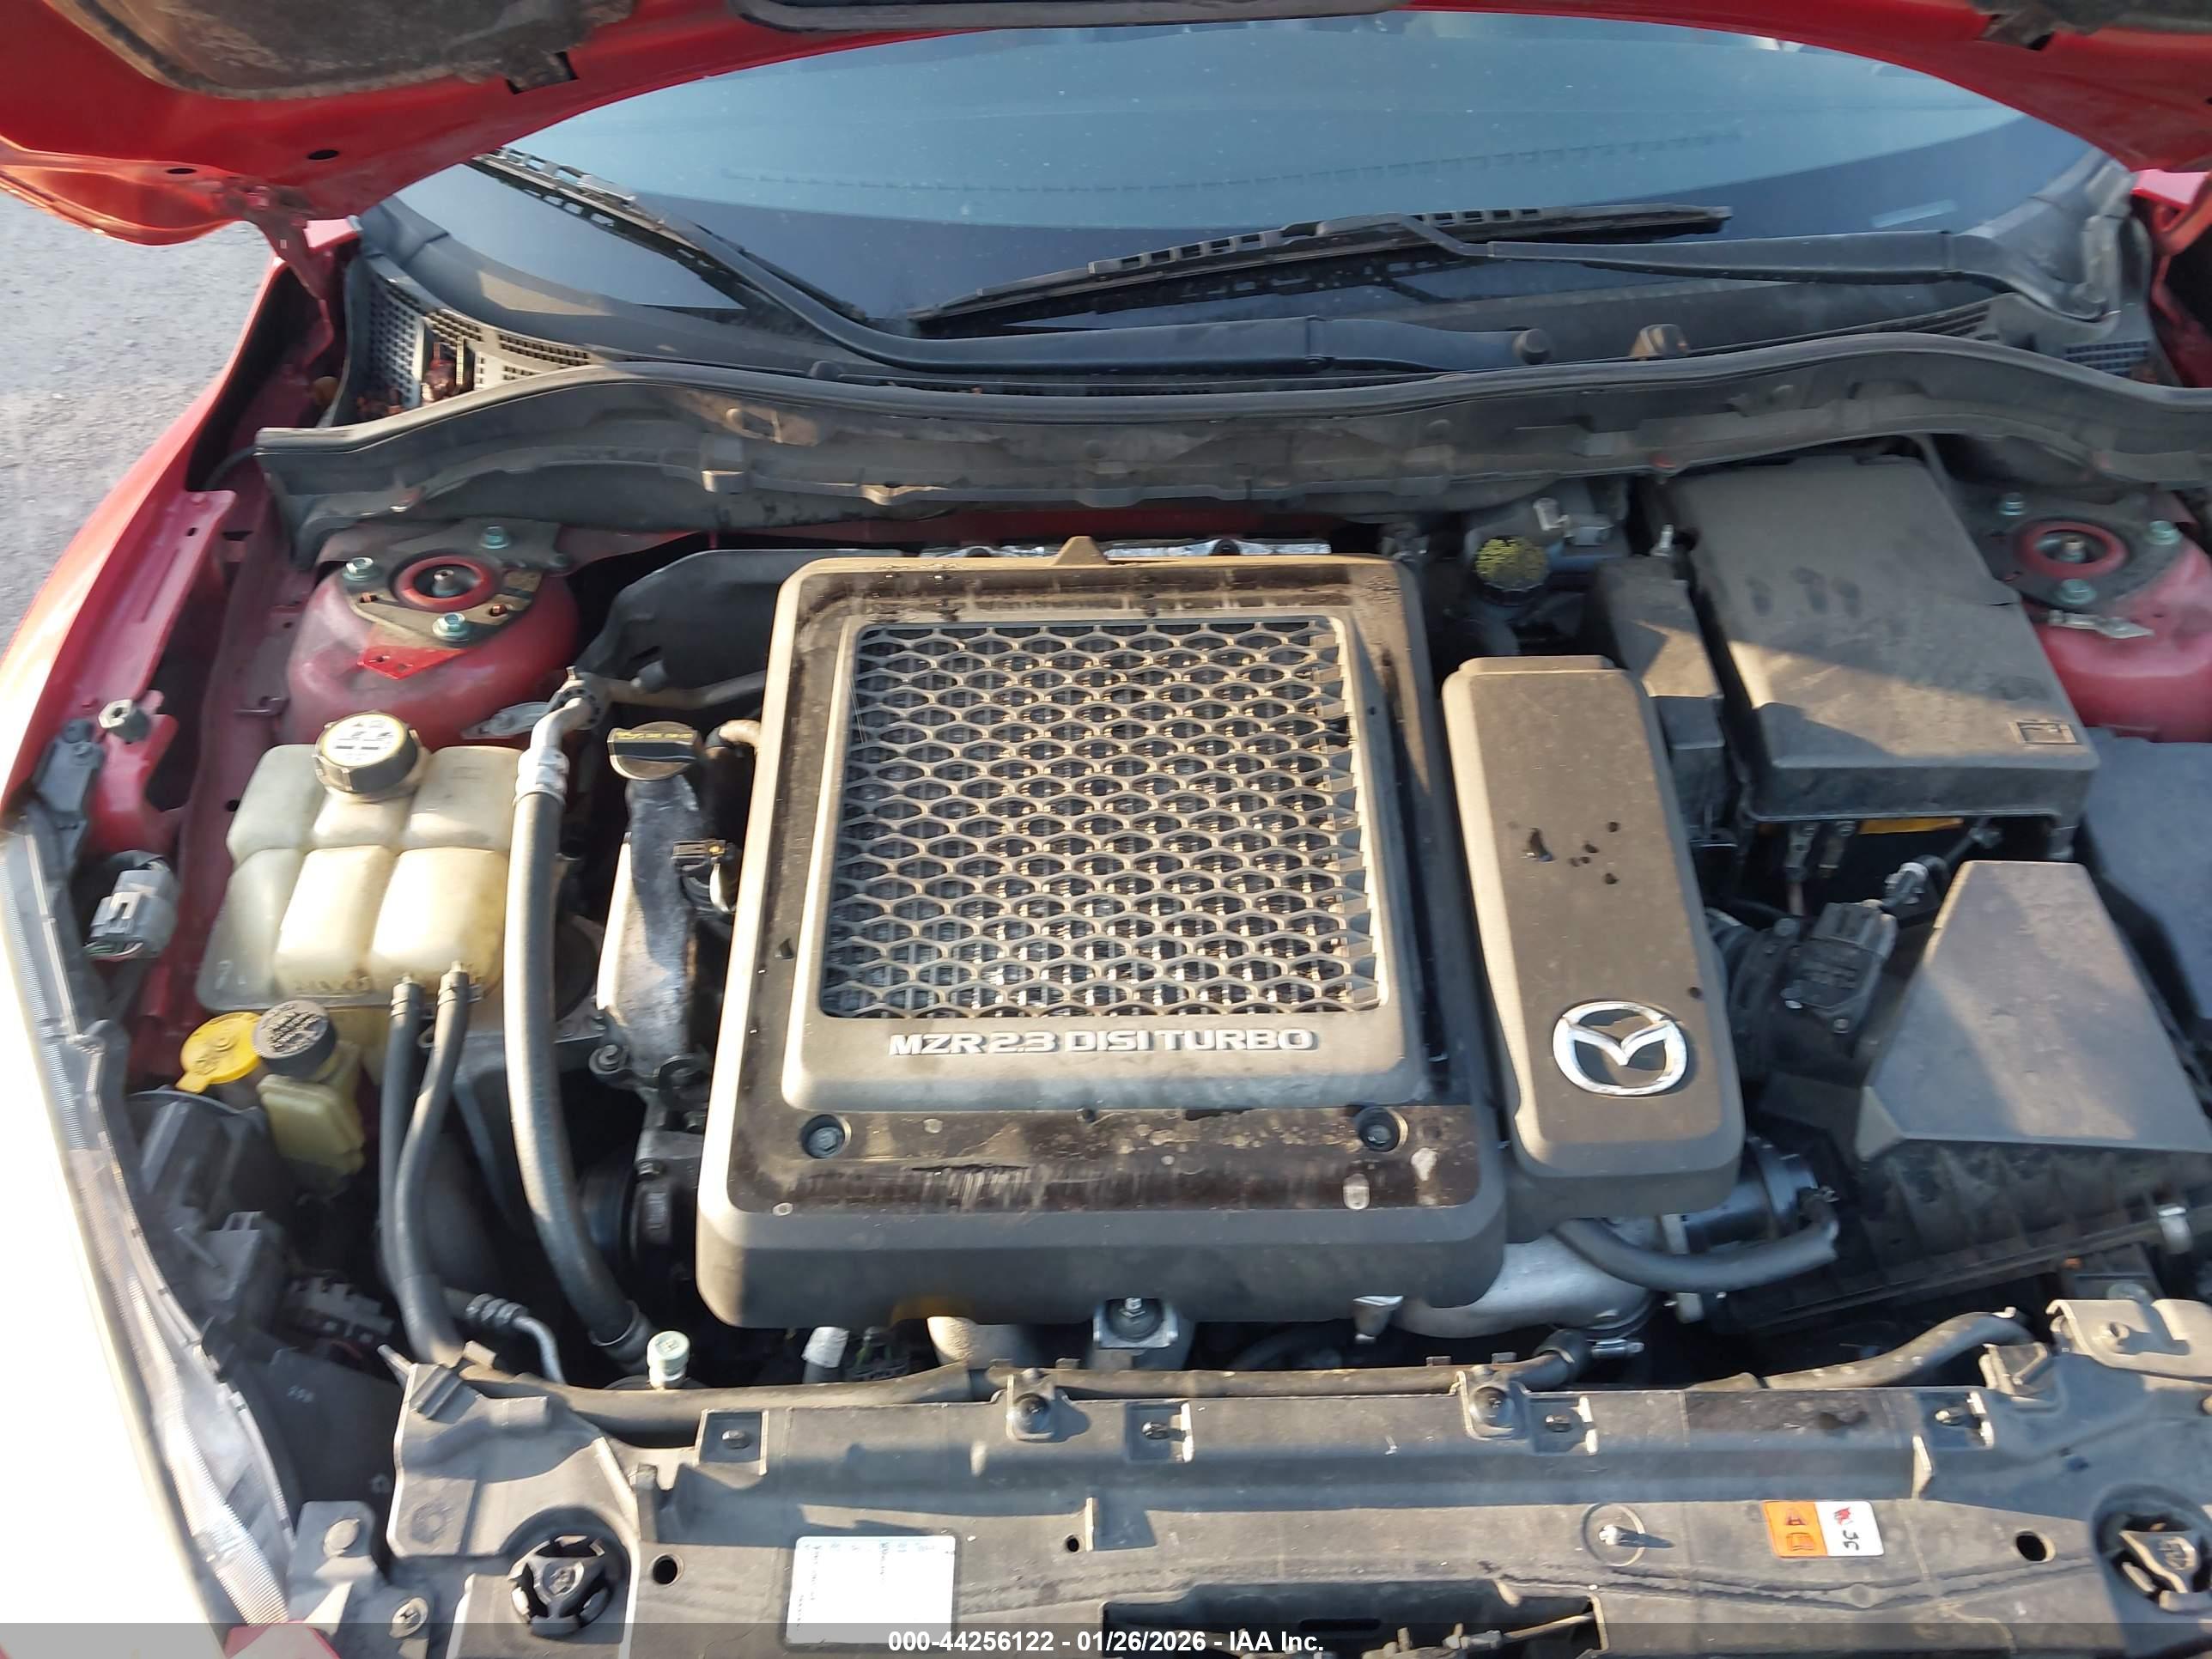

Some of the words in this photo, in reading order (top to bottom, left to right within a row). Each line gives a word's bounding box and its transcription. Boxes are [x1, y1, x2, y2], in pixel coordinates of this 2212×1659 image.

[890, 1032, 985, 1055] MZR
[988, 1030, 1057, 1053] 2.3
[1064, 1030, 1152, 1052] DISI
[1154, 1028, 1317, 1051] TURBO
